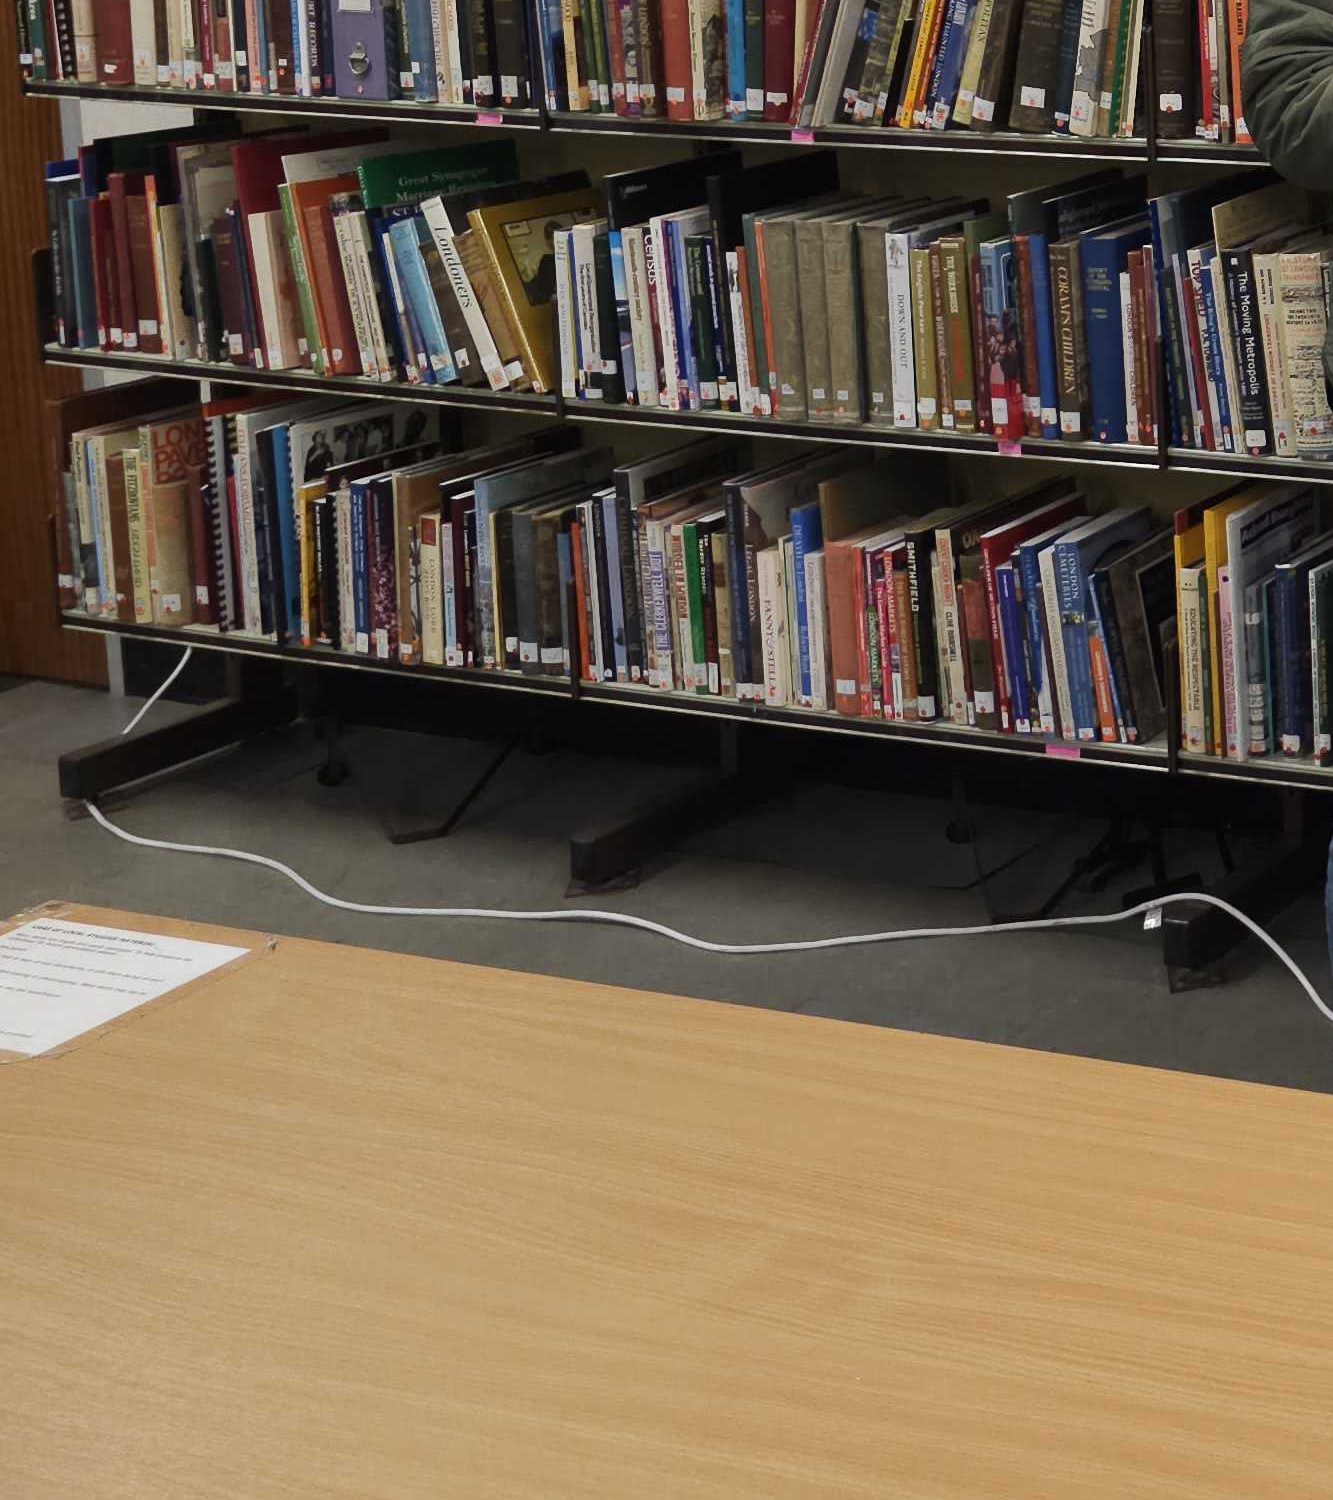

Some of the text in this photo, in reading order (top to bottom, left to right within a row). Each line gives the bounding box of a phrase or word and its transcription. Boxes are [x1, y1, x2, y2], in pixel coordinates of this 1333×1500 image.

[434, 225, 472, 309] Londoners
[1057, 267, 1075, 394] CORAM'S CHILDREN
[1238, 272, 1259, 395] The Moving Metropolis
[906, 541, 920, 612] SMITHFIELD
[1059, 545, 1071, 609] CEMETERIES
[1067, 552, 1079, 599] LONDON
